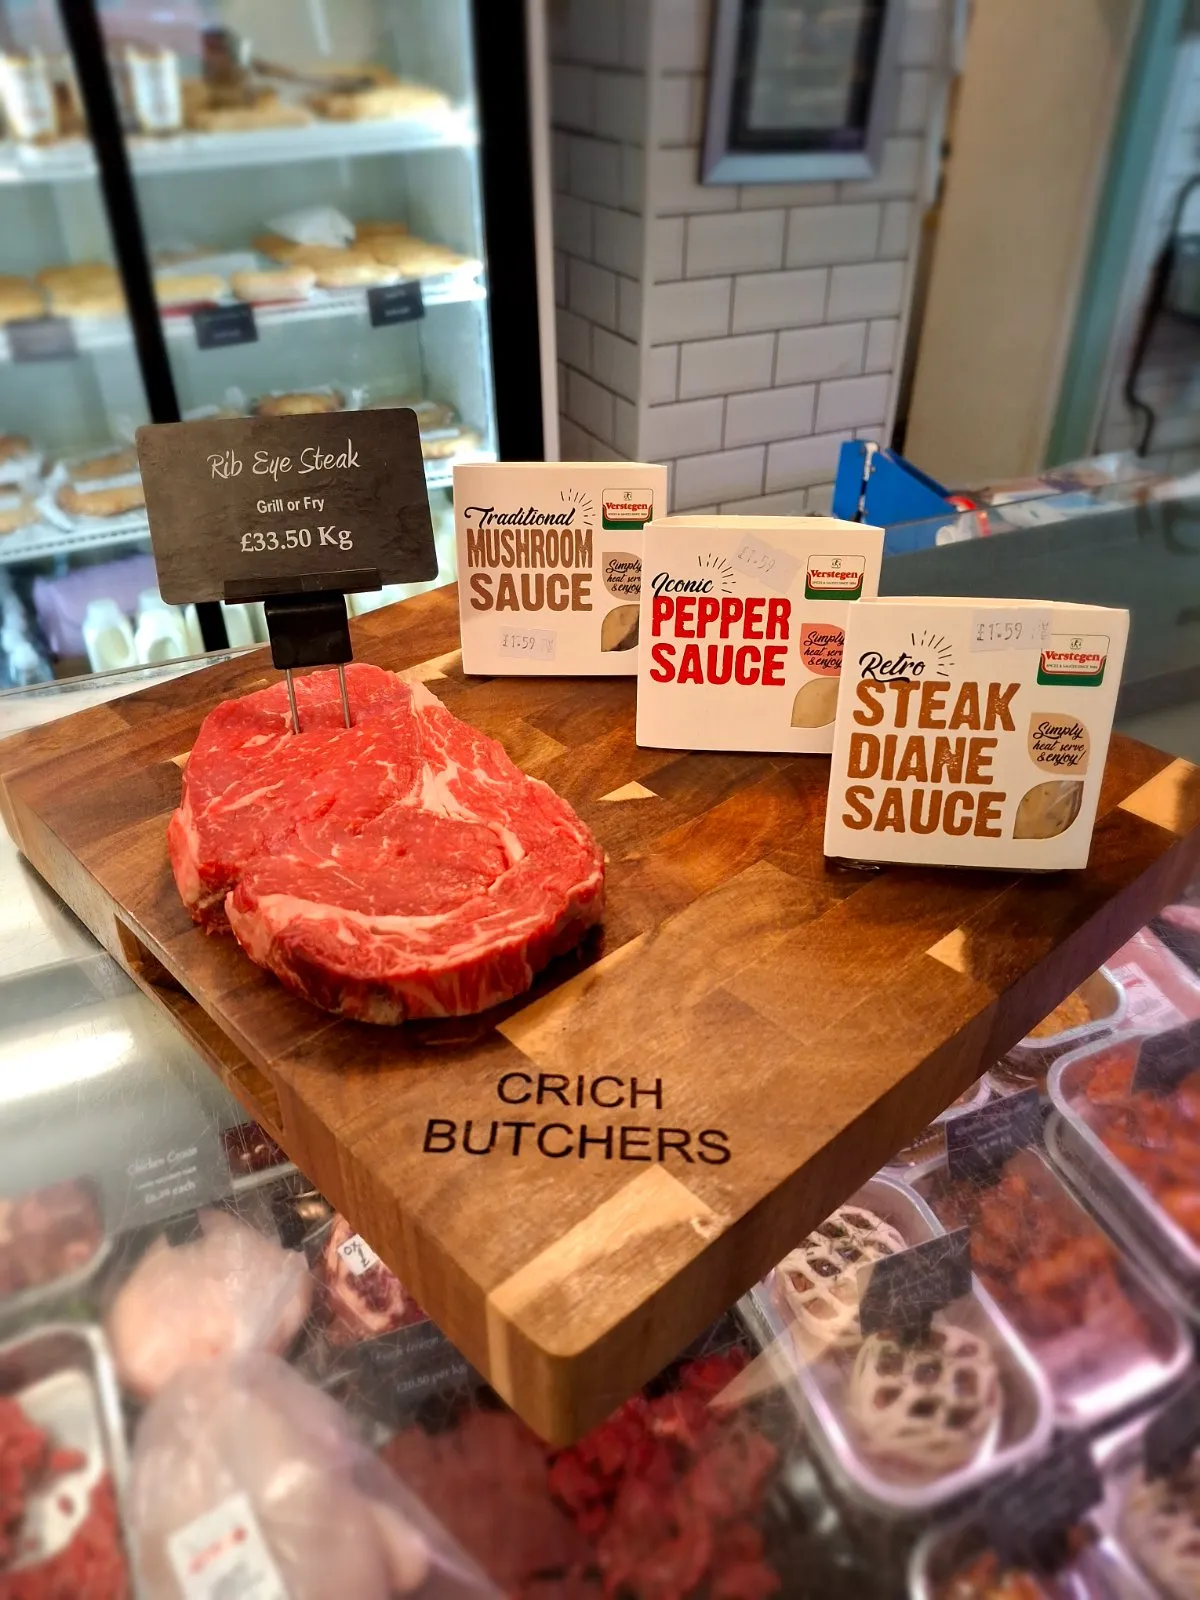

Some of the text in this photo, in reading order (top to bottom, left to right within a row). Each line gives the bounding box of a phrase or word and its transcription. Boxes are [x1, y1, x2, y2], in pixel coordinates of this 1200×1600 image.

[207, 438, 360, 482] Rib Eye Steak
[256, 496, 325, 514] Grill or Fry
[606, 502, 648, 512] Verstegen
[464, 506, 576, 529] Traditional
[240, 525, 353, 552] £33.50 Kg
[466, 528, 593, 568] MUSHROOM
[606, 559, 642, 574] Simply
[607, 574, 627, 582] heat
[811, 570, 858, 580] Verstegen
[470, 573, 592, 612] SAUCE
[651, 572, 714, 596] Iconic
[652, 596, 792, 640] PEPPER
[804, 631, 844, 646] Simply
[976, 622, 1022, 640] £1.59
[804, 647, 827, 656] heat
[1046, 651, 1100, 663] Verstegen
[650, 643, 788, 686] SAUCE
[859, 652, 926, 683] Retro
[852, 680, 1021, 732] STEAK
[1033, 721, 1084, 740] Simply
[1033, 740, 1060, 750] heat
[846, 732, 998, 785] DIANE
[842, 785, 1006, 838] SAUCE
[497, 1072, 663, 1109] CRICH
[422, 1118, 731, 1164] BUTCHERS
